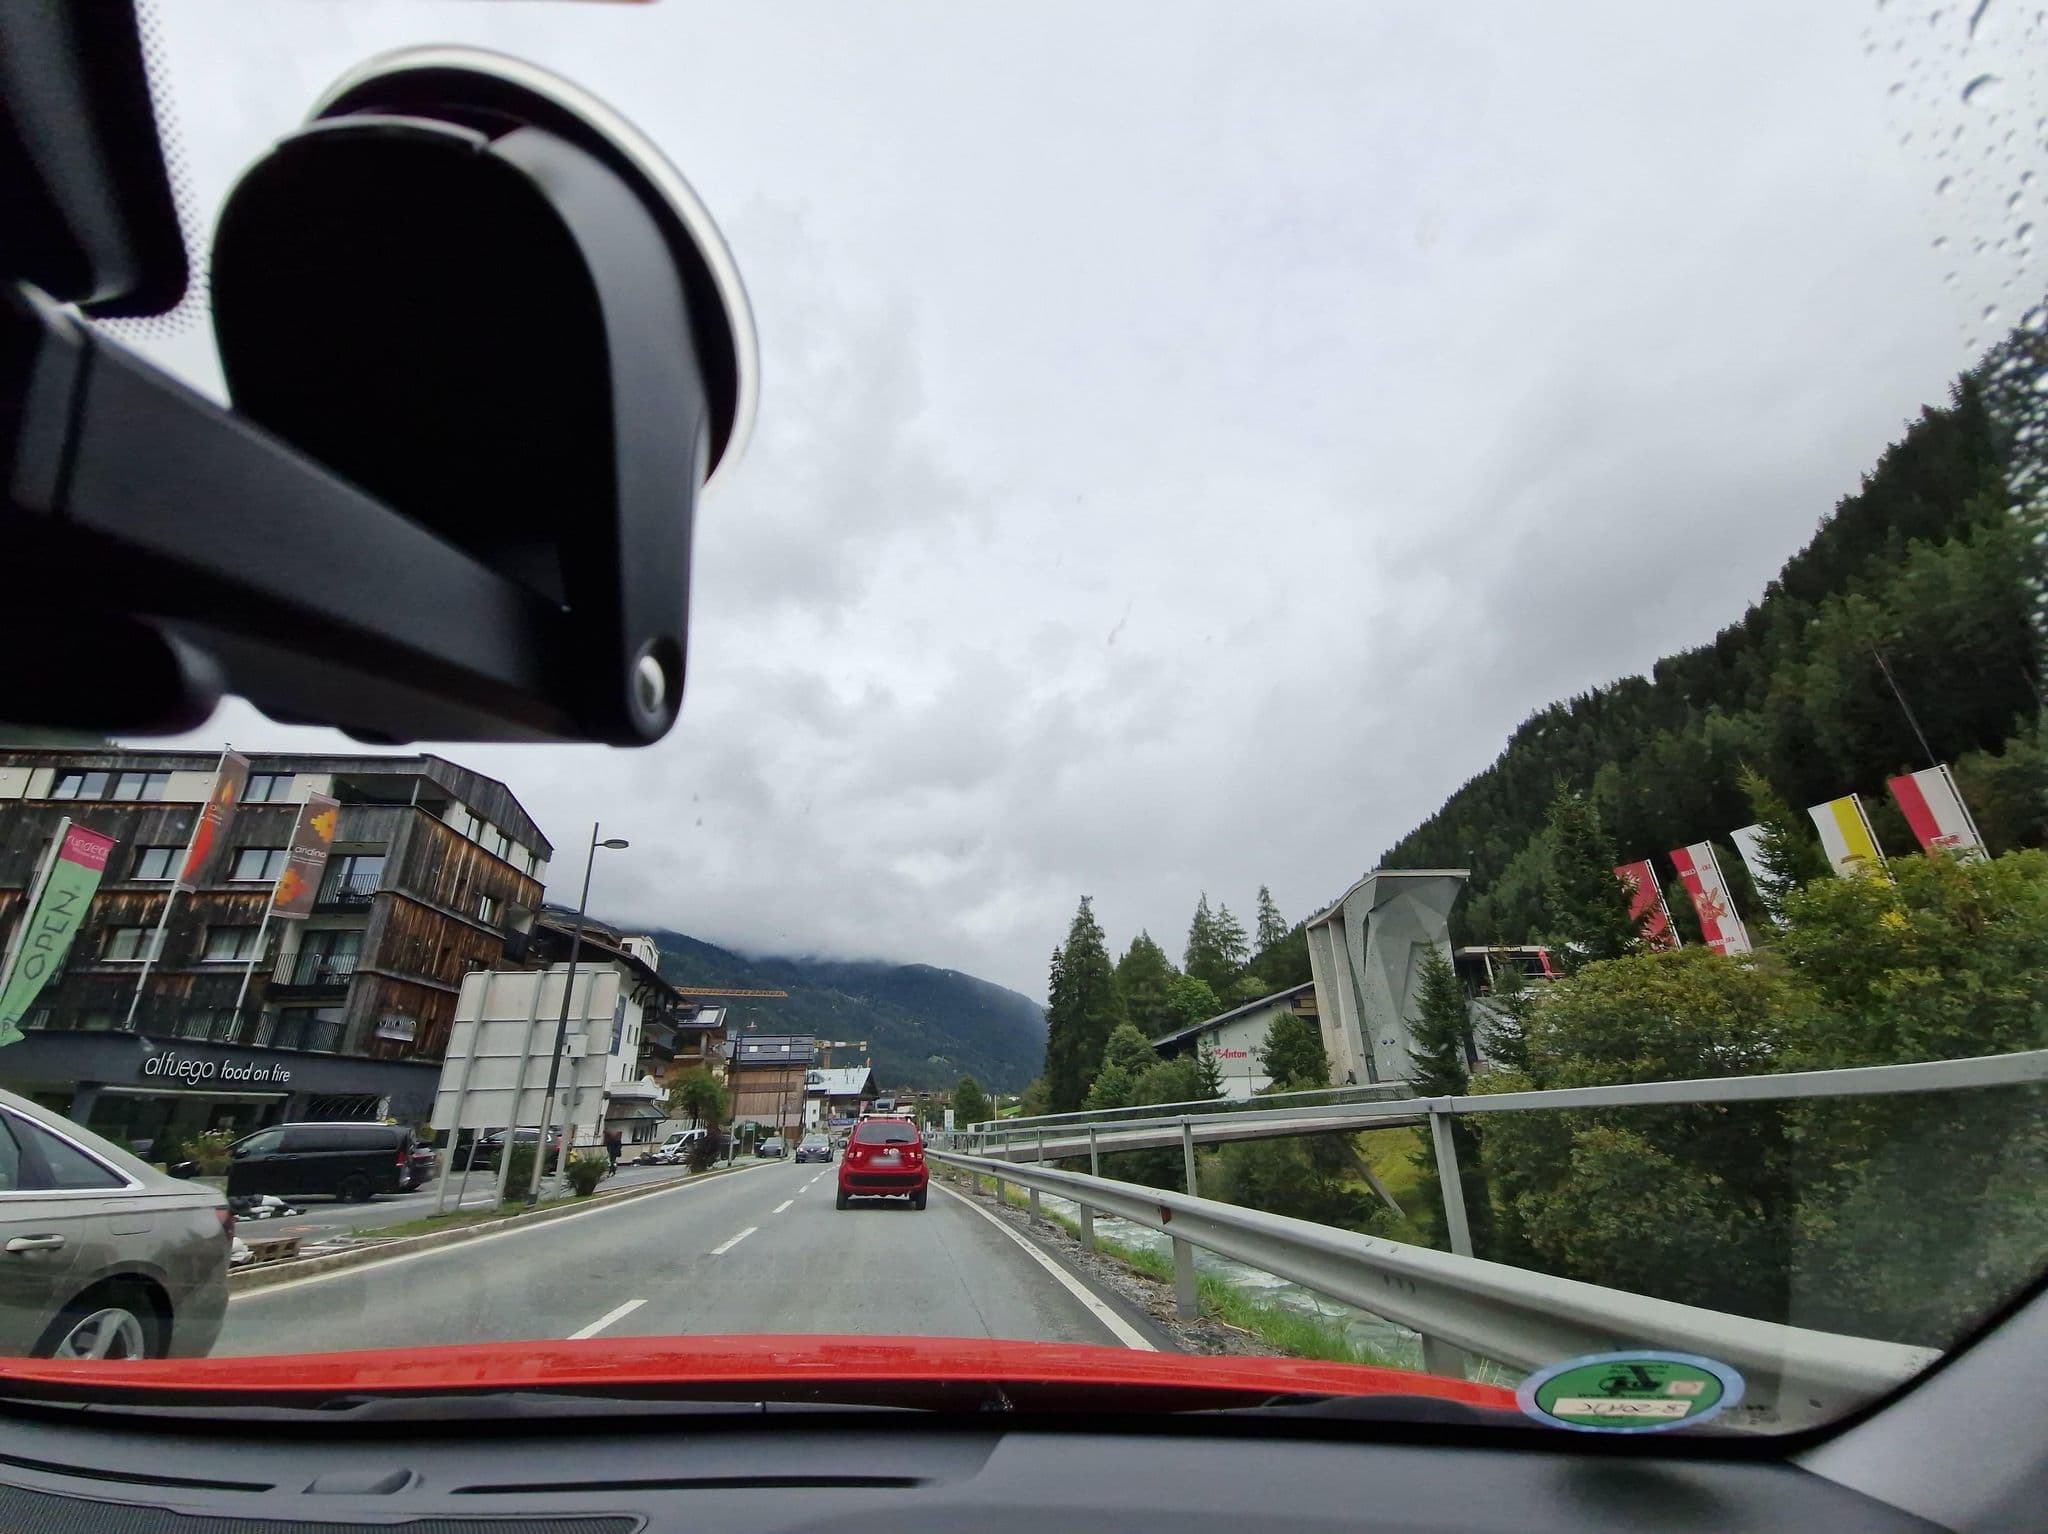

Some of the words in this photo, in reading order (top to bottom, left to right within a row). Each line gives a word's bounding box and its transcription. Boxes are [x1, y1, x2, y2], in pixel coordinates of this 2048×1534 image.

[24, 889, 80, 980] OPEN
[144, 1051, 215, 1085] alfuego
[220, 1059, 254, 1080] food
[253, 1068, 269, 1081] on
[271, 1063, 291, 1082] fire
[1219, 1047, 1248, 1059] Anton
